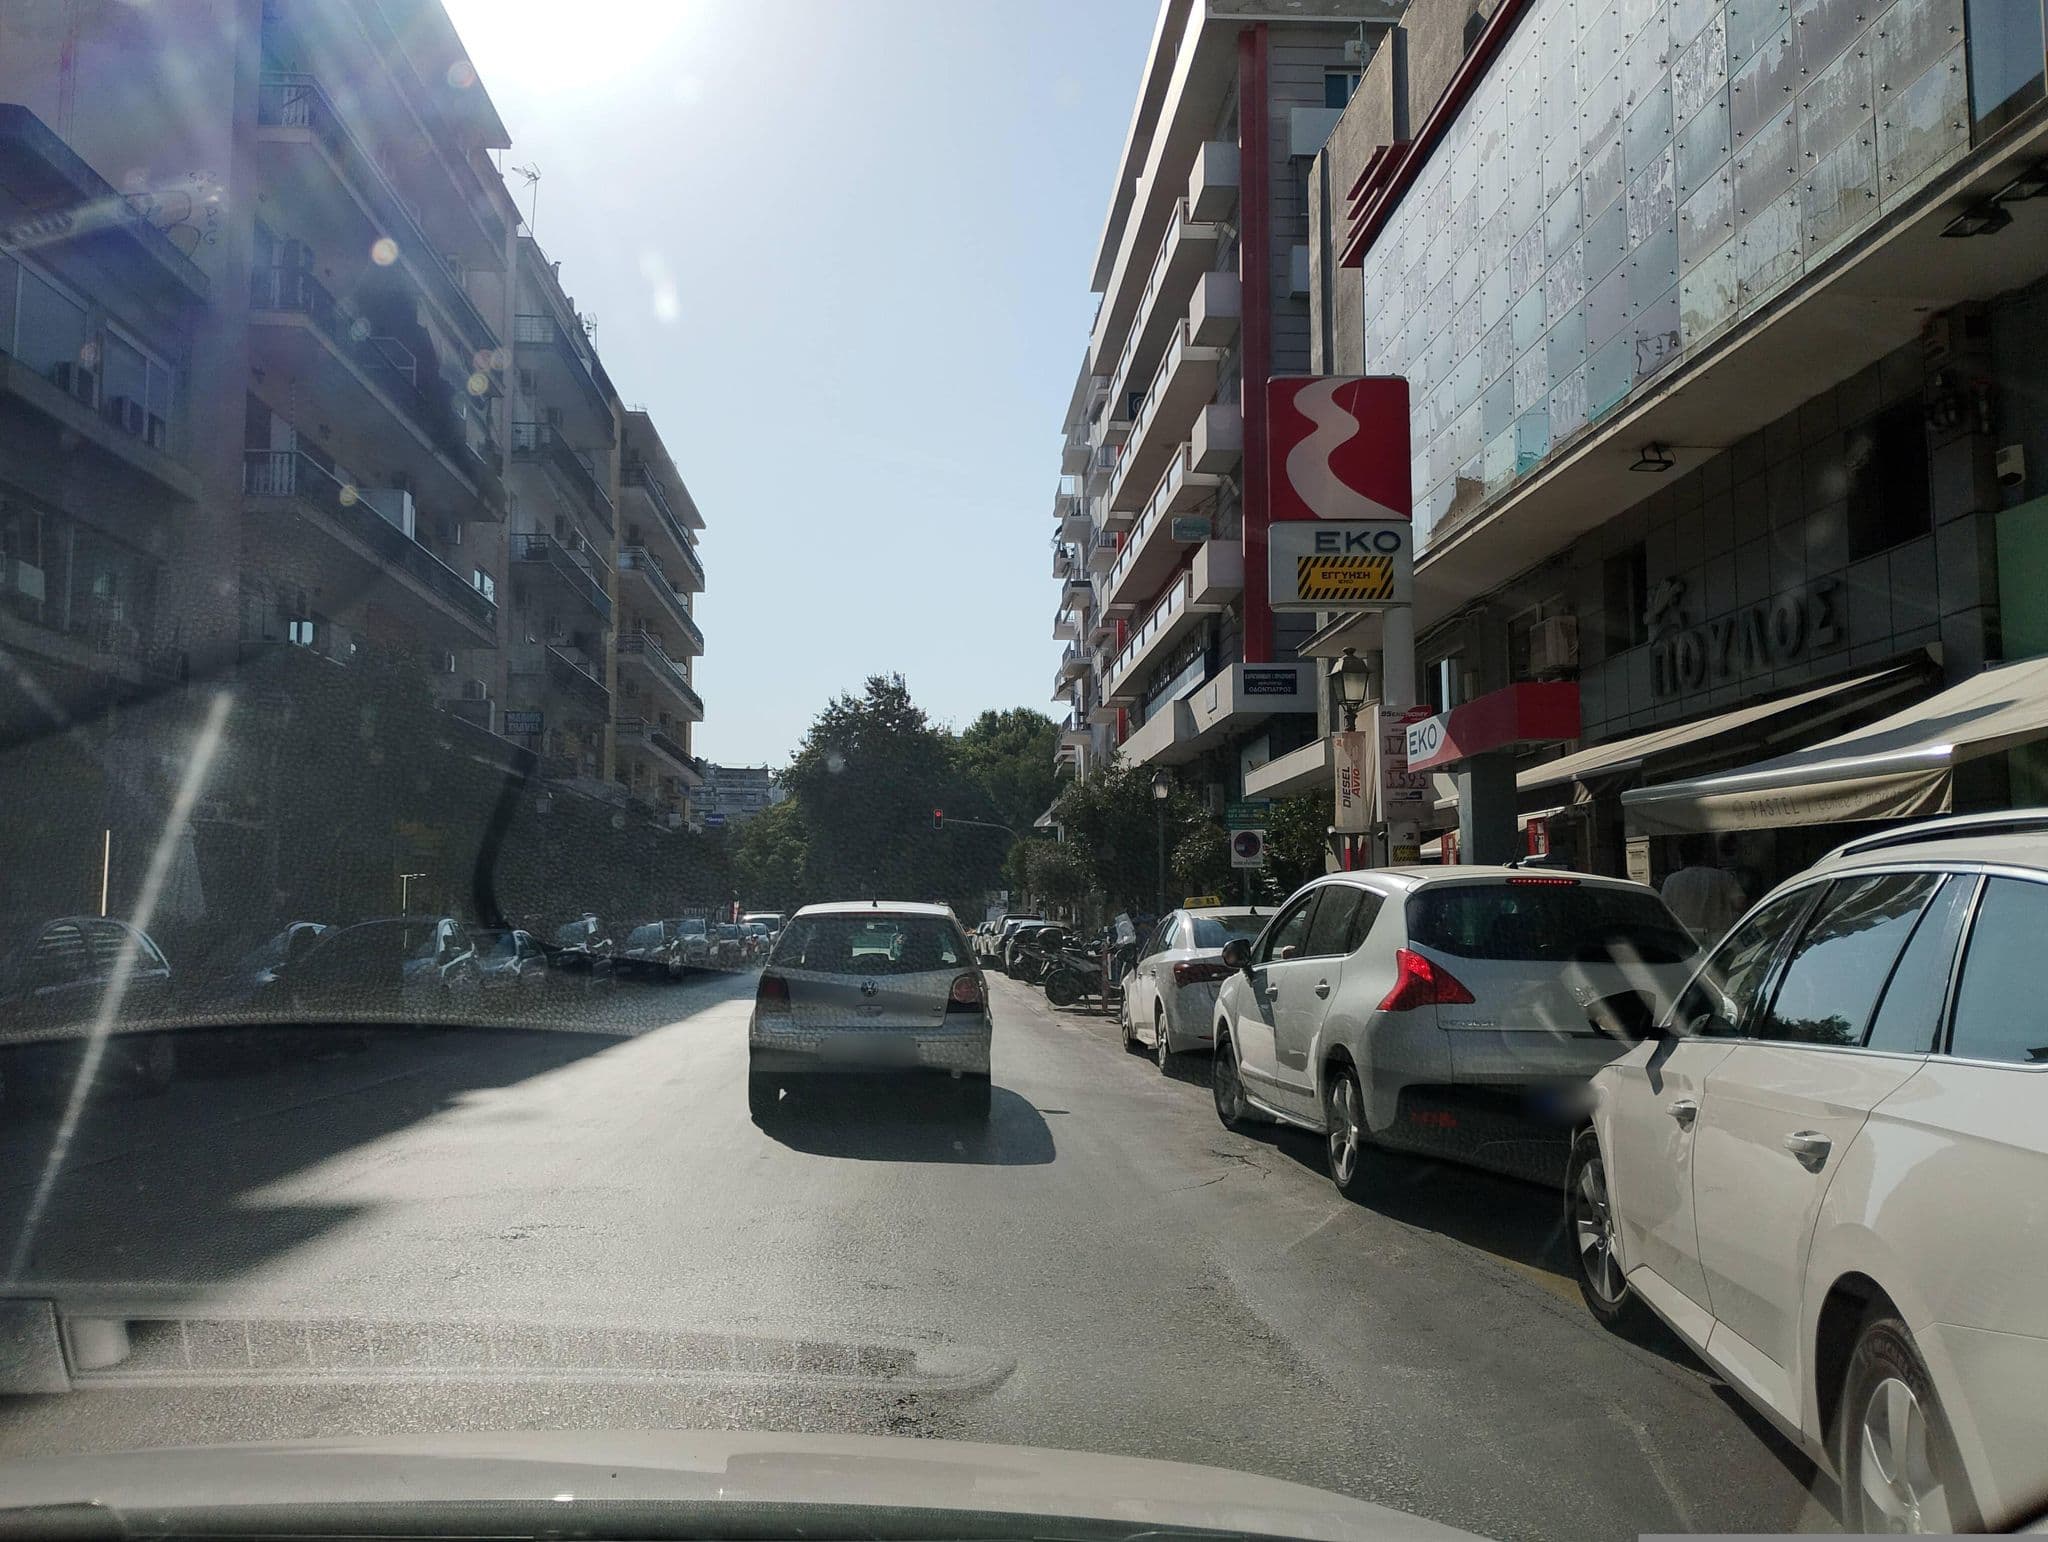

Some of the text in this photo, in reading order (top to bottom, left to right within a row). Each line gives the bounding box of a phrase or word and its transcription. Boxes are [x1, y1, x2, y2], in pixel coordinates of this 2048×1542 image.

[1315, 531, 1401, 553] EKO
[1321, 570, 1371, 580] ΕΓΓΥΗΣΗ
[1409, 723, 1437, 755] EKO
[1342, 766, 1352, 808] DIESEL
